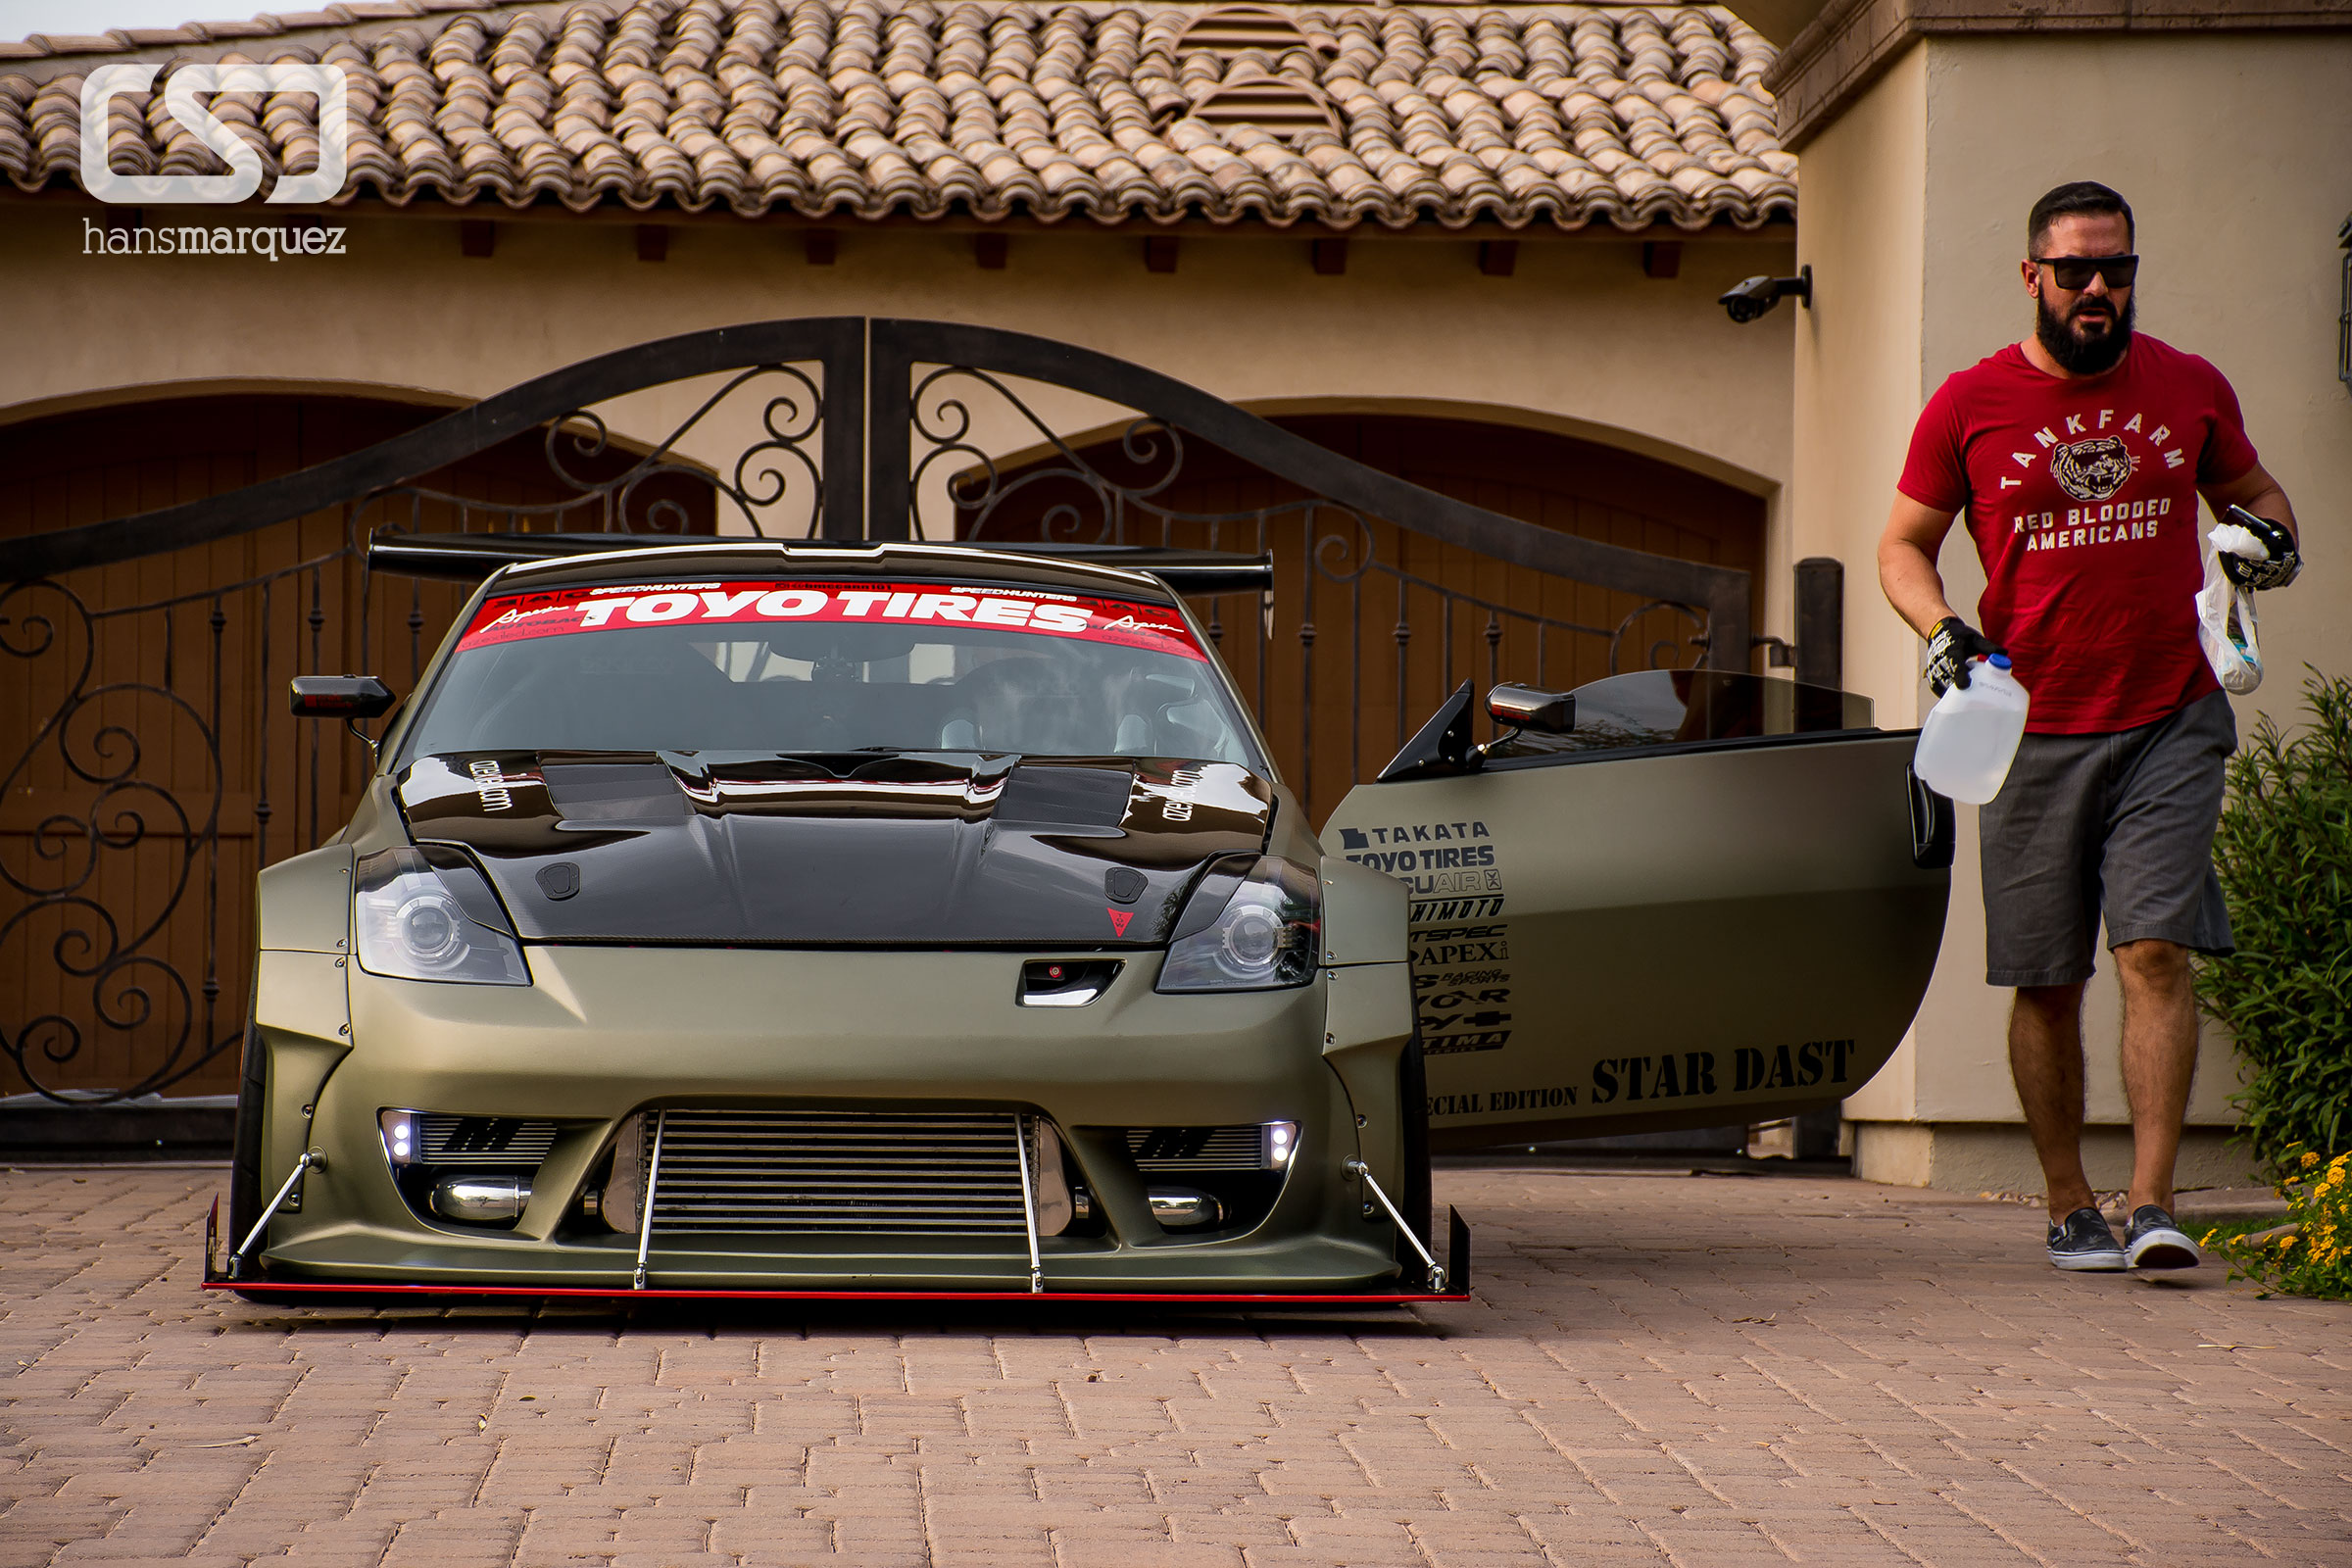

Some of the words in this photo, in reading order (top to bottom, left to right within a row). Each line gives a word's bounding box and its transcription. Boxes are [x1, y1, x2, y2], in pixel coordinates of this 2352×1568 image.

[2013, 512, 2054, 534] RED
[2067, 497, 2171, 526] BLOODED
[2027, 519, 2158, 552] AMERICANS
[950, 586, 1078, 602] SPEEDHUNTERS
[1372, 821, 1490, 844] TAKATA
[1490, 1086, 1578, 1112] EDITION
[1592, 1051, 1717, 1104] STAR
[1734, 1039, 1855, 1094] DAST
